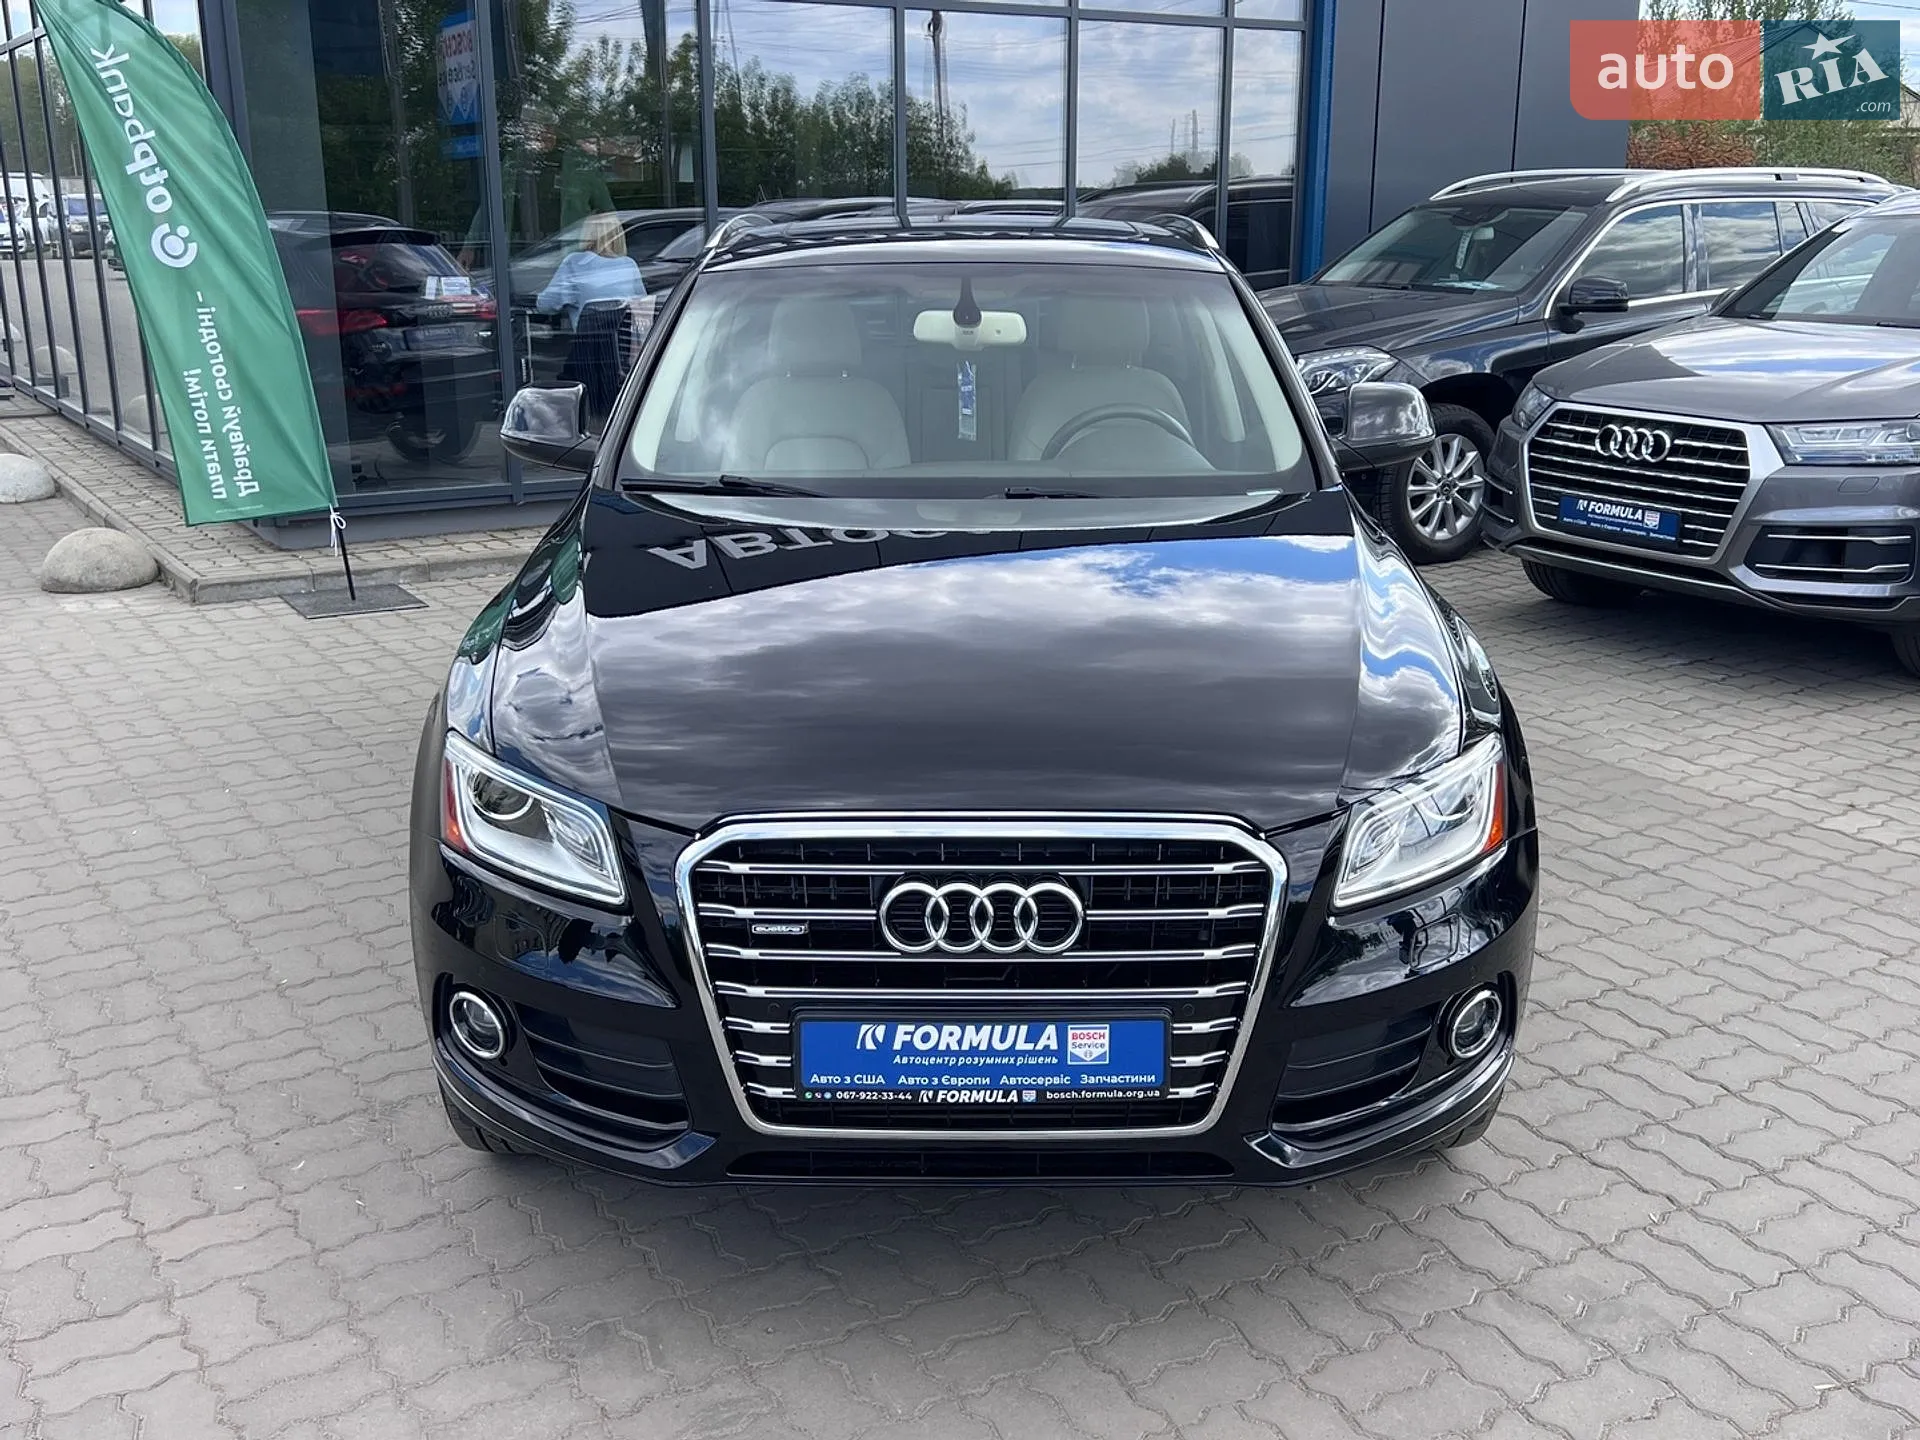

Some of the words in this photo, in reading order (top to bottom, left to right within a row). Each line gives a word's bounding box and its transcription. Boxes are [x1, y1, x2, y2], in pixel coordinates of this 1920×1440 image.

[1588, 501, 1643, 520] FORMULA
[893, 1024, 1058, 1050] FORMULA
[1071, 1032, 1106, 1040] BOSCH
[1071, 1041, 1106, 1049] Service
[893, 1055, 958, 1066] Автоцентр
[958, 1057, 1014, 1066] розумних
[1016, 1054, 1058, 1066] рішень
[810, 1074, 841, 1084] Авто
[844, 1076, 851, 1084] з
[854, 1074, 886, 1084] США
[898, 1075, 929, 1084] Авто
[932, 1077, 939, 1085] з
[941, 1075, 991, 1087] Європи
[1000, 1074, 1071, 1086] Автосервіс
[1080, 1074, 1155, 1084] Запчастини
[836, 1091, 912, 1100] 067-922-33-44
[937, 1090, 1018, 1103] FORMULA
[1046, 1089, 1160, 1100] bosch.formula.org.ua
